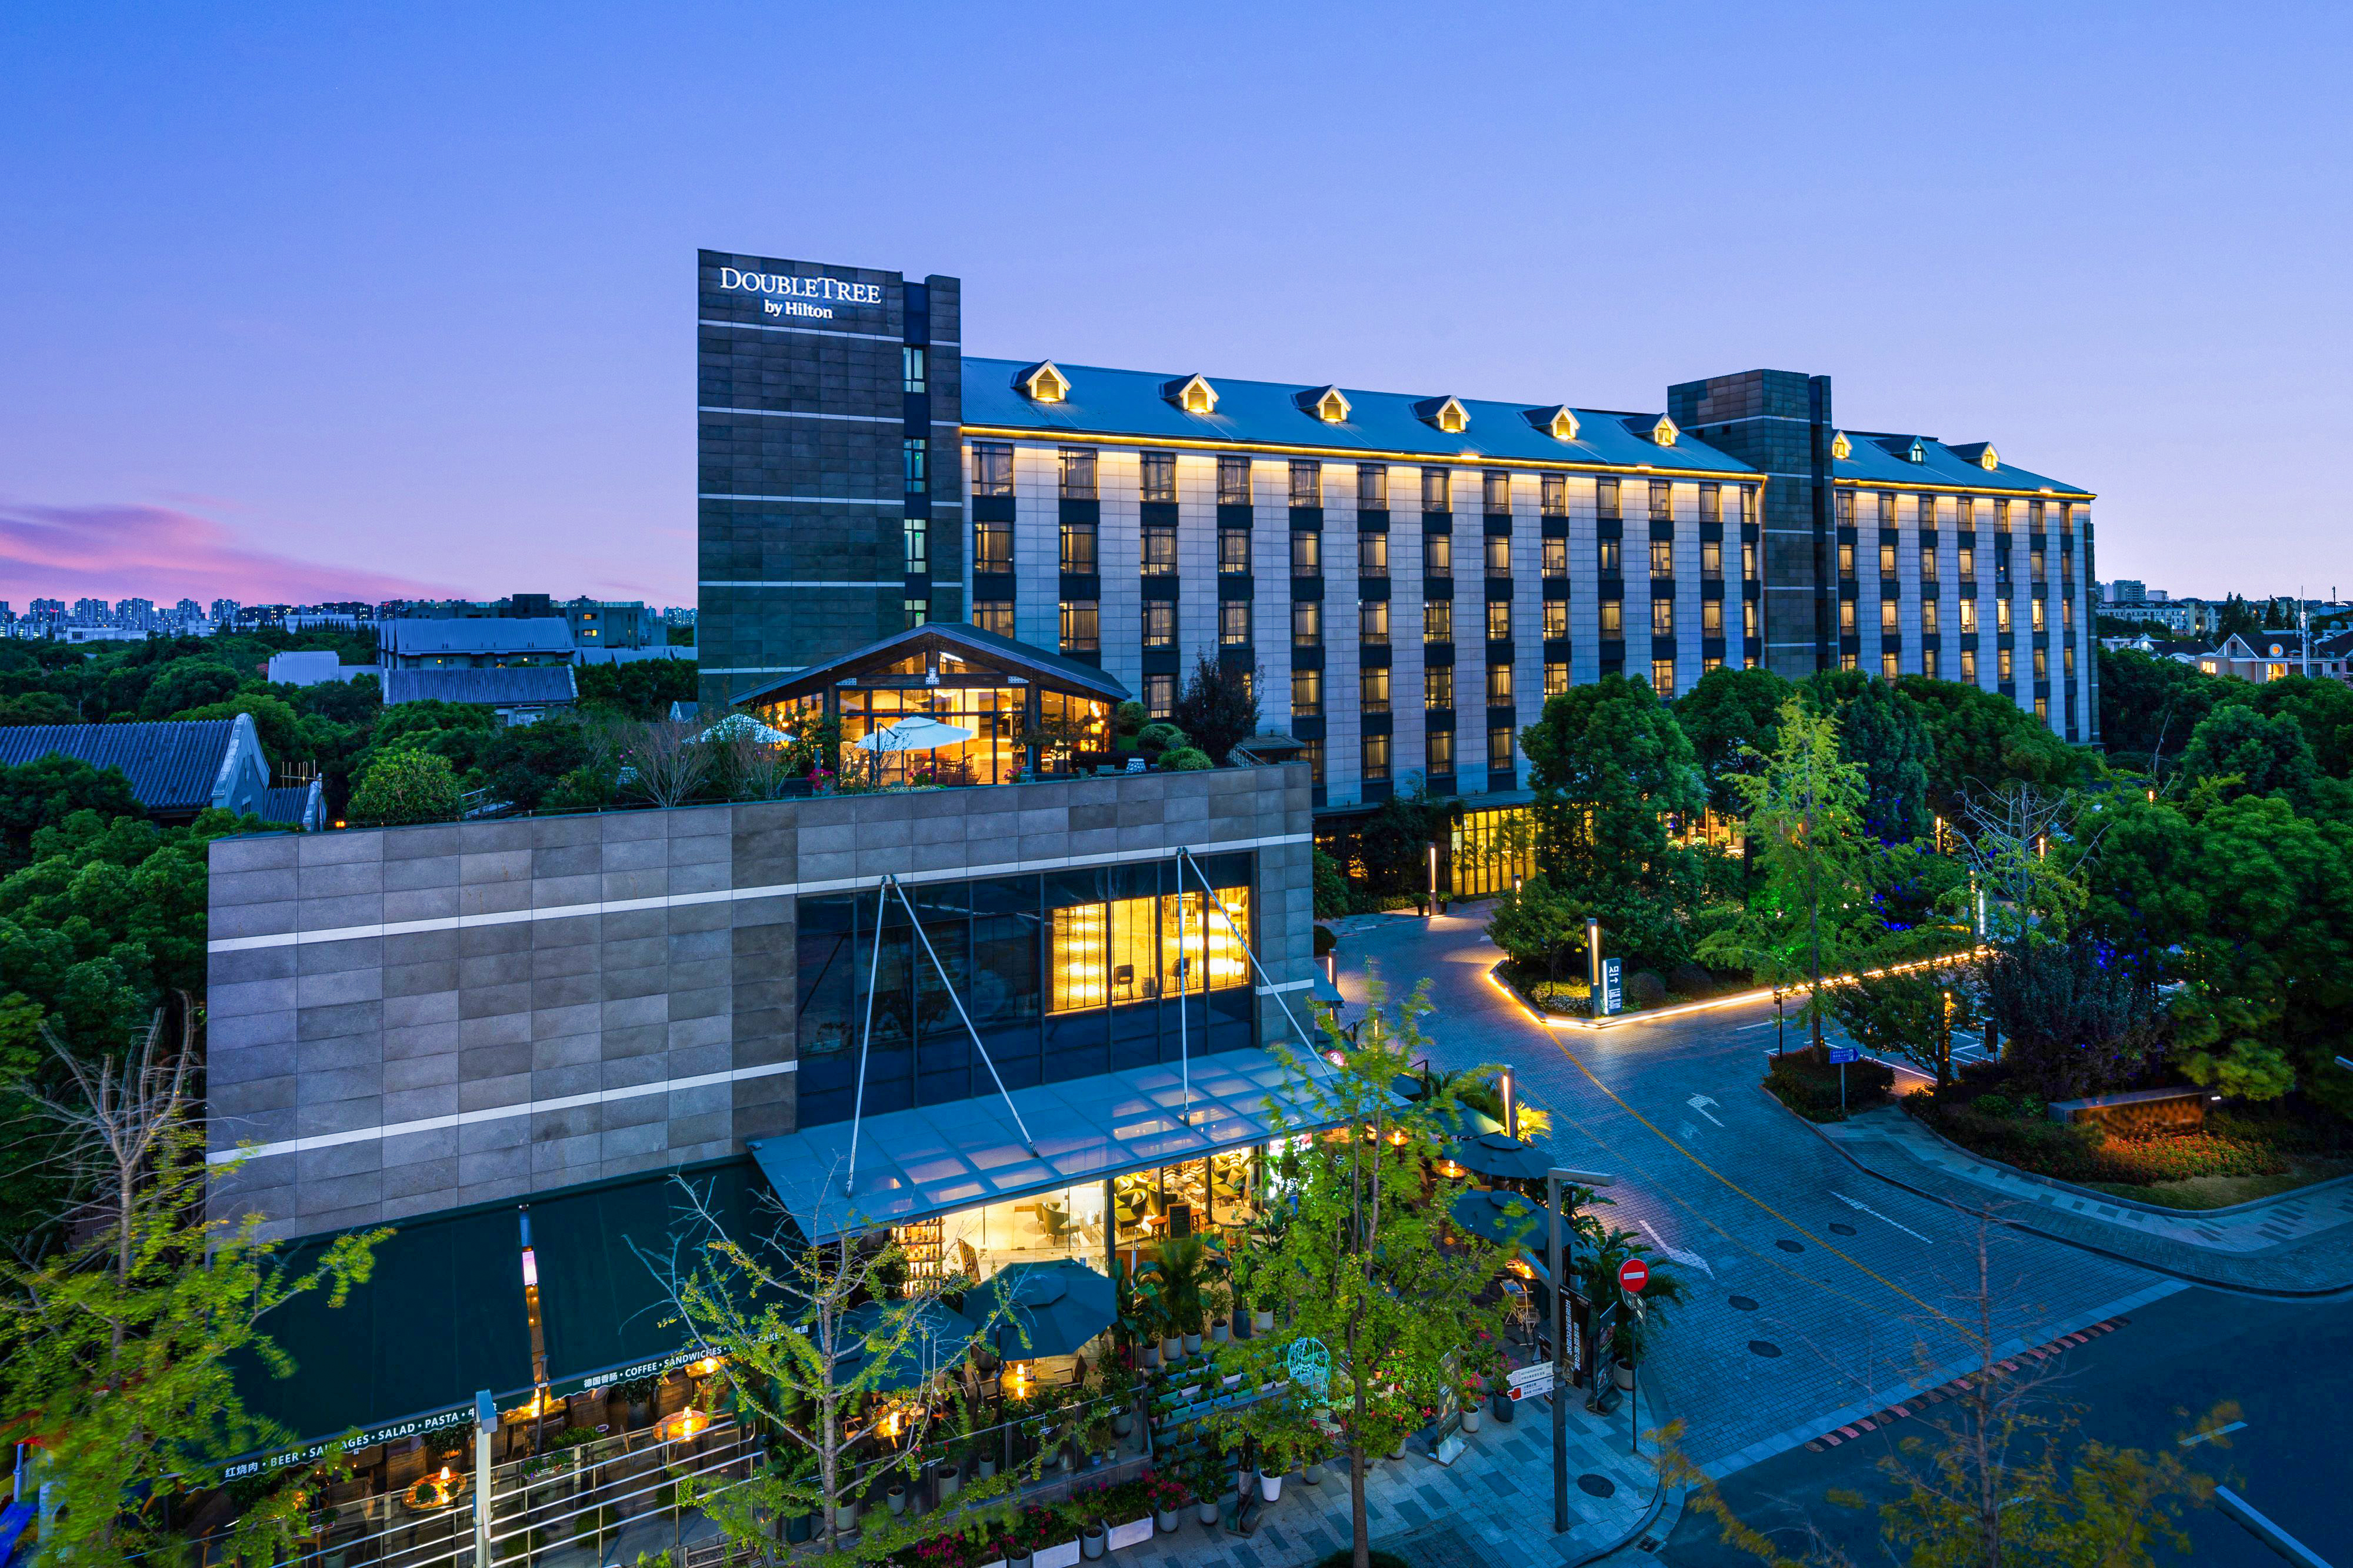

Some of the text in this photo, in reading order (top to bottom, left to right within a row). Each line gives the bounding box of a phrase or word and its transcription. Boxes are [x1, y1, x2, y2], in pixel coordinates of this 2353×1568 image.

[764, 299, 833, 319] by Hilton
[584, 1372, 618, 1388] 德国香肠
[625, 1362, 657, 1377] COFFEE
[664, 1346, 722, 1367] SANDWICHES
[758, 1332, 780, 1343] CAKE
[225, 1412, 459, 1478] 红烧肉 BEER SAAGES SALAD PASTA
